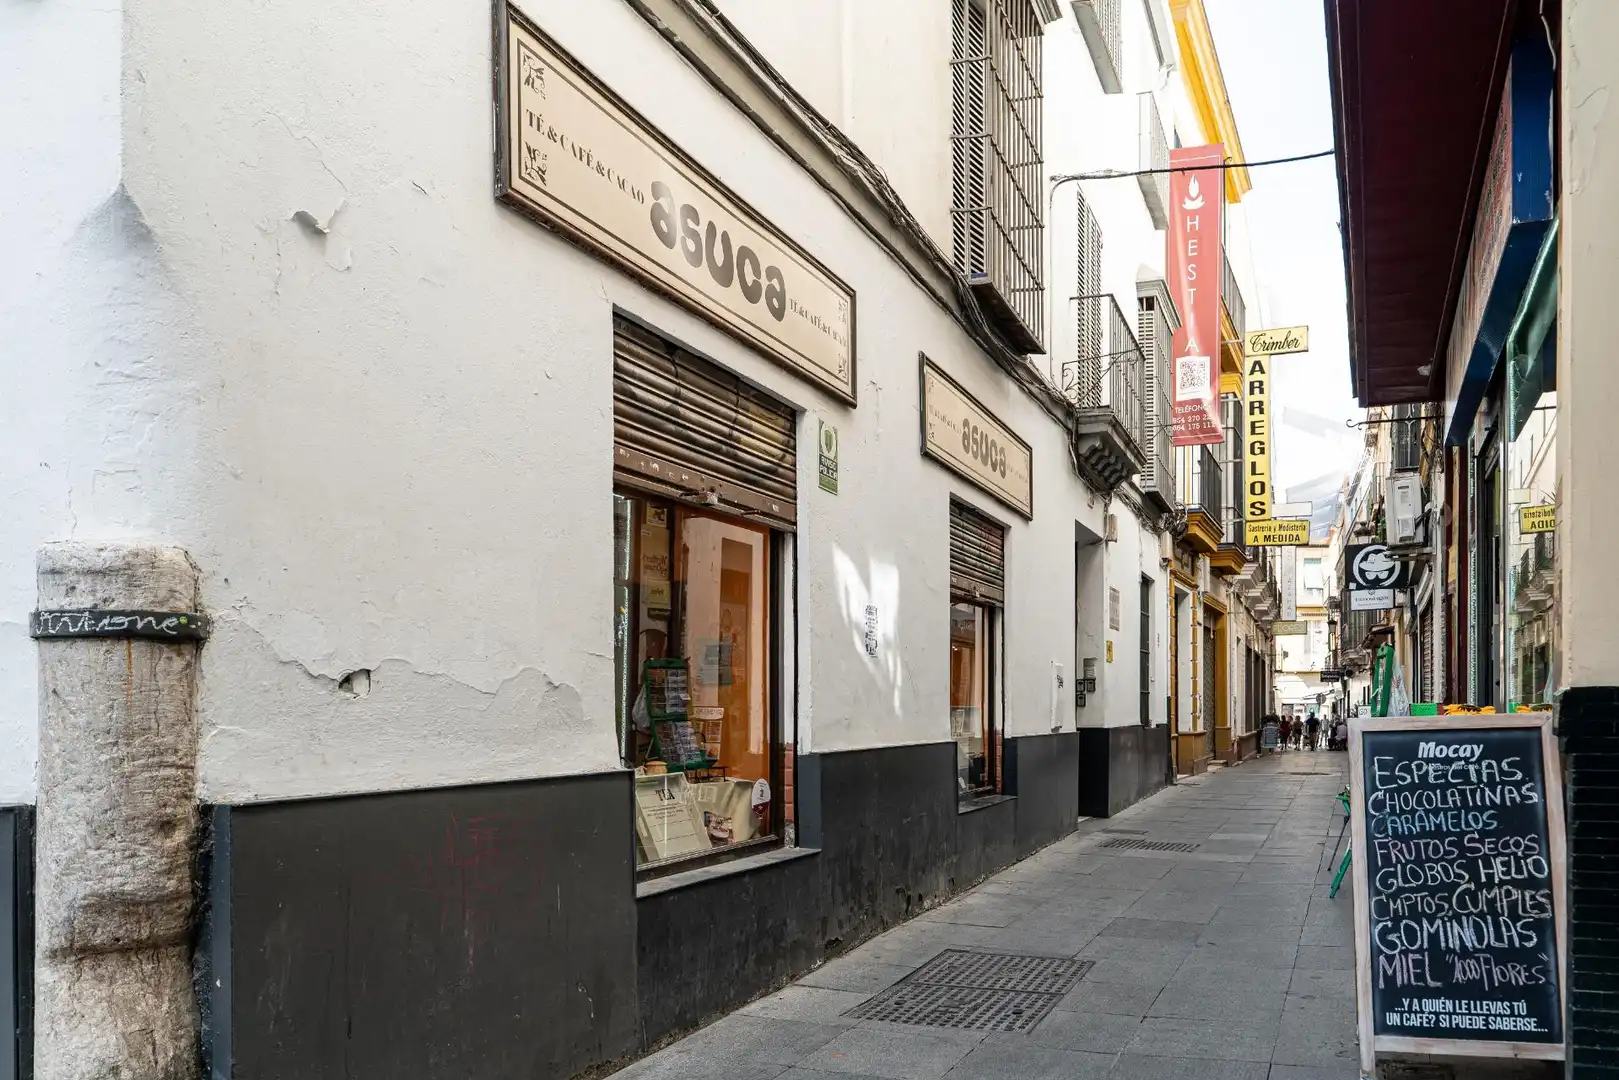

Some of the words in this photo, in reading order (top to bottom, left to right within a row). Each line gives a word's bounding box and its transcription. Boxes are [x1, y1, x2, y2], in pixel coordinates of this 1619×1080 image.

[650, 181, 786, 322] asuca
[1185, 215, 1199, 352] HESTIA
[1250, 331, 1303, 353] Trimber
[962, 418, 1006, 479] asuca
[1249, 360, 1266, 516] ARREGLOS
[1253, 535, 1259, 543] A
[1263, 533, 1300, 543] MEDIDA
[1418, 742, 1483, 761] Mocay
[1374, 756, 1523, 789] ESPECIAS
[1368, 783, 1538, 815] CHOCOLATINAS
[1372, 809, 1498, 837] CARAMELOS
[1374, 837, 1459, 866] FRUTOS
[1464, 832, 1539, 856] SECOS
[1376, 859, 1469, 893] GLOBOS
[1478, 855, 1549, 884] HELIO
[1452, 881, 1552, 918] CUMPLES
[1375, 916, 1538, 955] GOMINOLAS
[1379, 952, 1444, 989] MIEL
[1386, 1012, 1401, 1026] UN
[1403, 1011, 1435, 1028] CAFÉ?
[1439, 1015, 1450, 1028] SI
[1452, 1015, 1486, 1029] PUEDE
[1488, 1016, 1548, 1032] SABERSE...
[1412, 999, 1420, 1012] A
[1422, 997, 1453, 1013] QUIÉN
[1455, 1000, 1469, 1013] LE
[1471, 1000, 1510, 1015] LLEVAS
[1512, 999, 1527, 1015] TÚ
